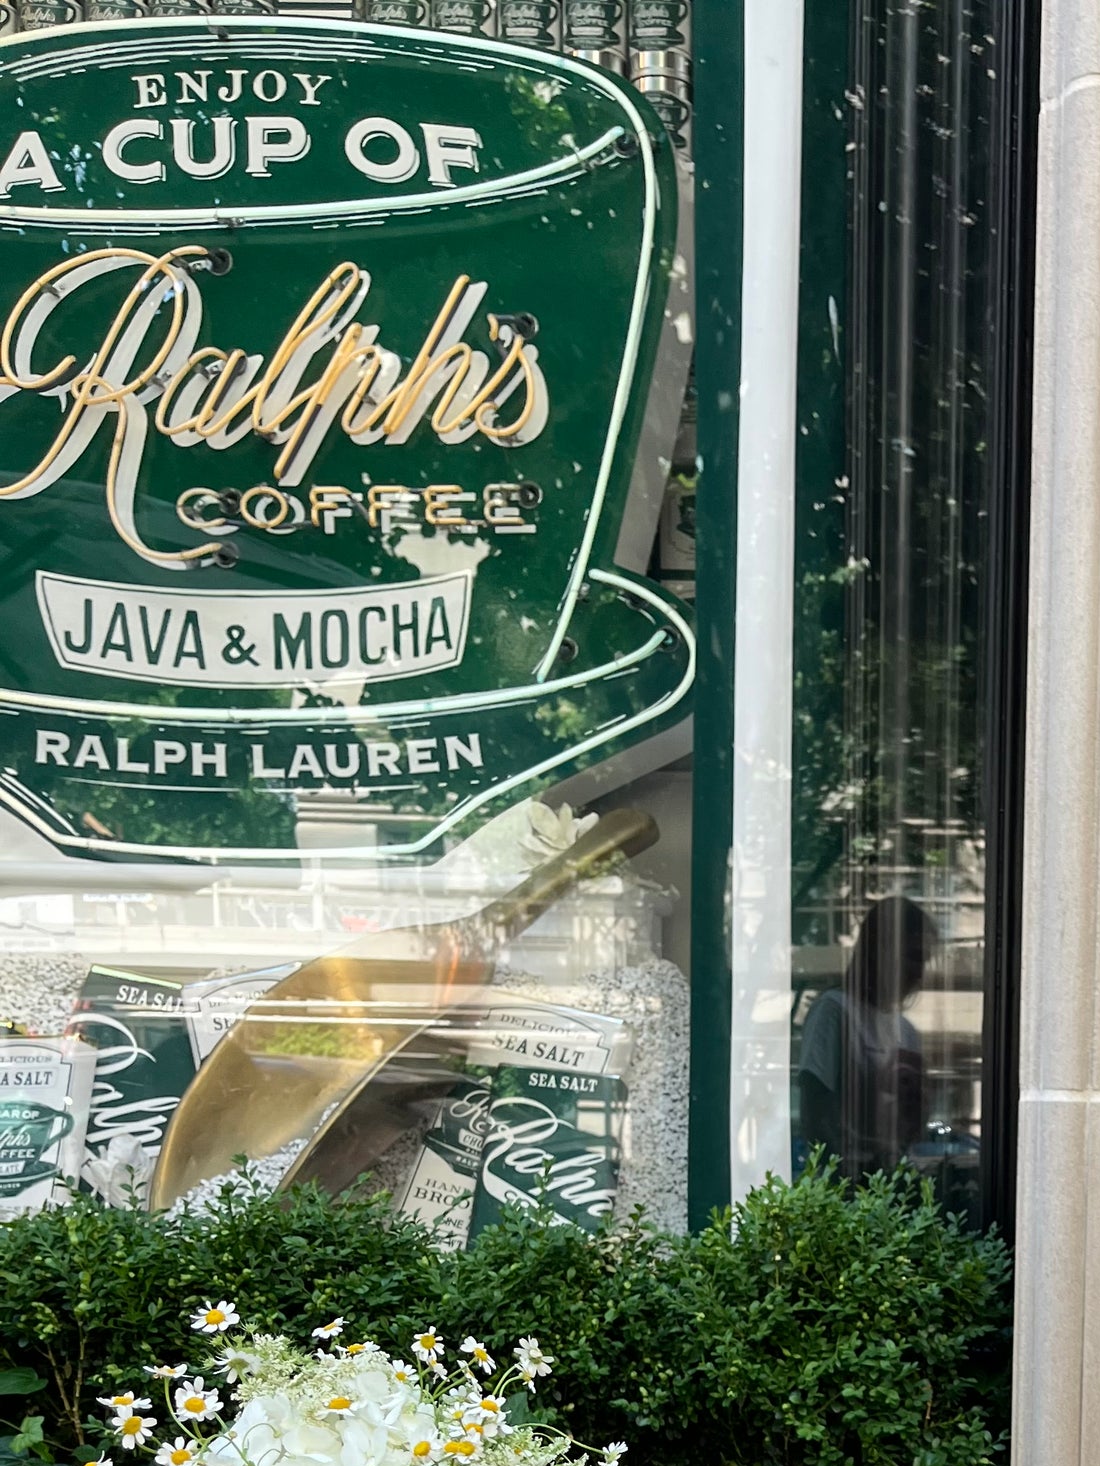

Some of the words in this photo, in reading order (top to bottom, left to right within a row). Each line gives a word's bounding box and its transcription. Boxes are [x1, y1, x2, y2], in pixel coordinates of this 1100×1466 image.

[131, 69, 332, 110] ENJOY
[0, 131, 66, 195] A
[102, 115, 311, 185] CUP
[344, 116, 484, 188] OF
[0, 244, 549, 570] Ralph's
[176, 484, 538, 535] COFFEE
[64, 597, 206, 669] JAVA
[221, 623, 259, 667] &
[273, 595, 455, 671] MOCHA
[35, 729, 228, 777] RALPH
[252, 733, 484, 779] LAUREN
[116, 984, 148, 1006] SEA
[151, 993, 184, 1012] SAL
[491, 1033, 528, 1055] SEA
[533, 1041, 586, 1068] SALT
[13, 1071, 53, 1086] SALT
[528, 1072, 556, 1089] SEA
[560, 1075, 599, 1093] SALT
[0, 1148, 36, 1159] FFEE
[455, 1155, 479, 1168] RALP
